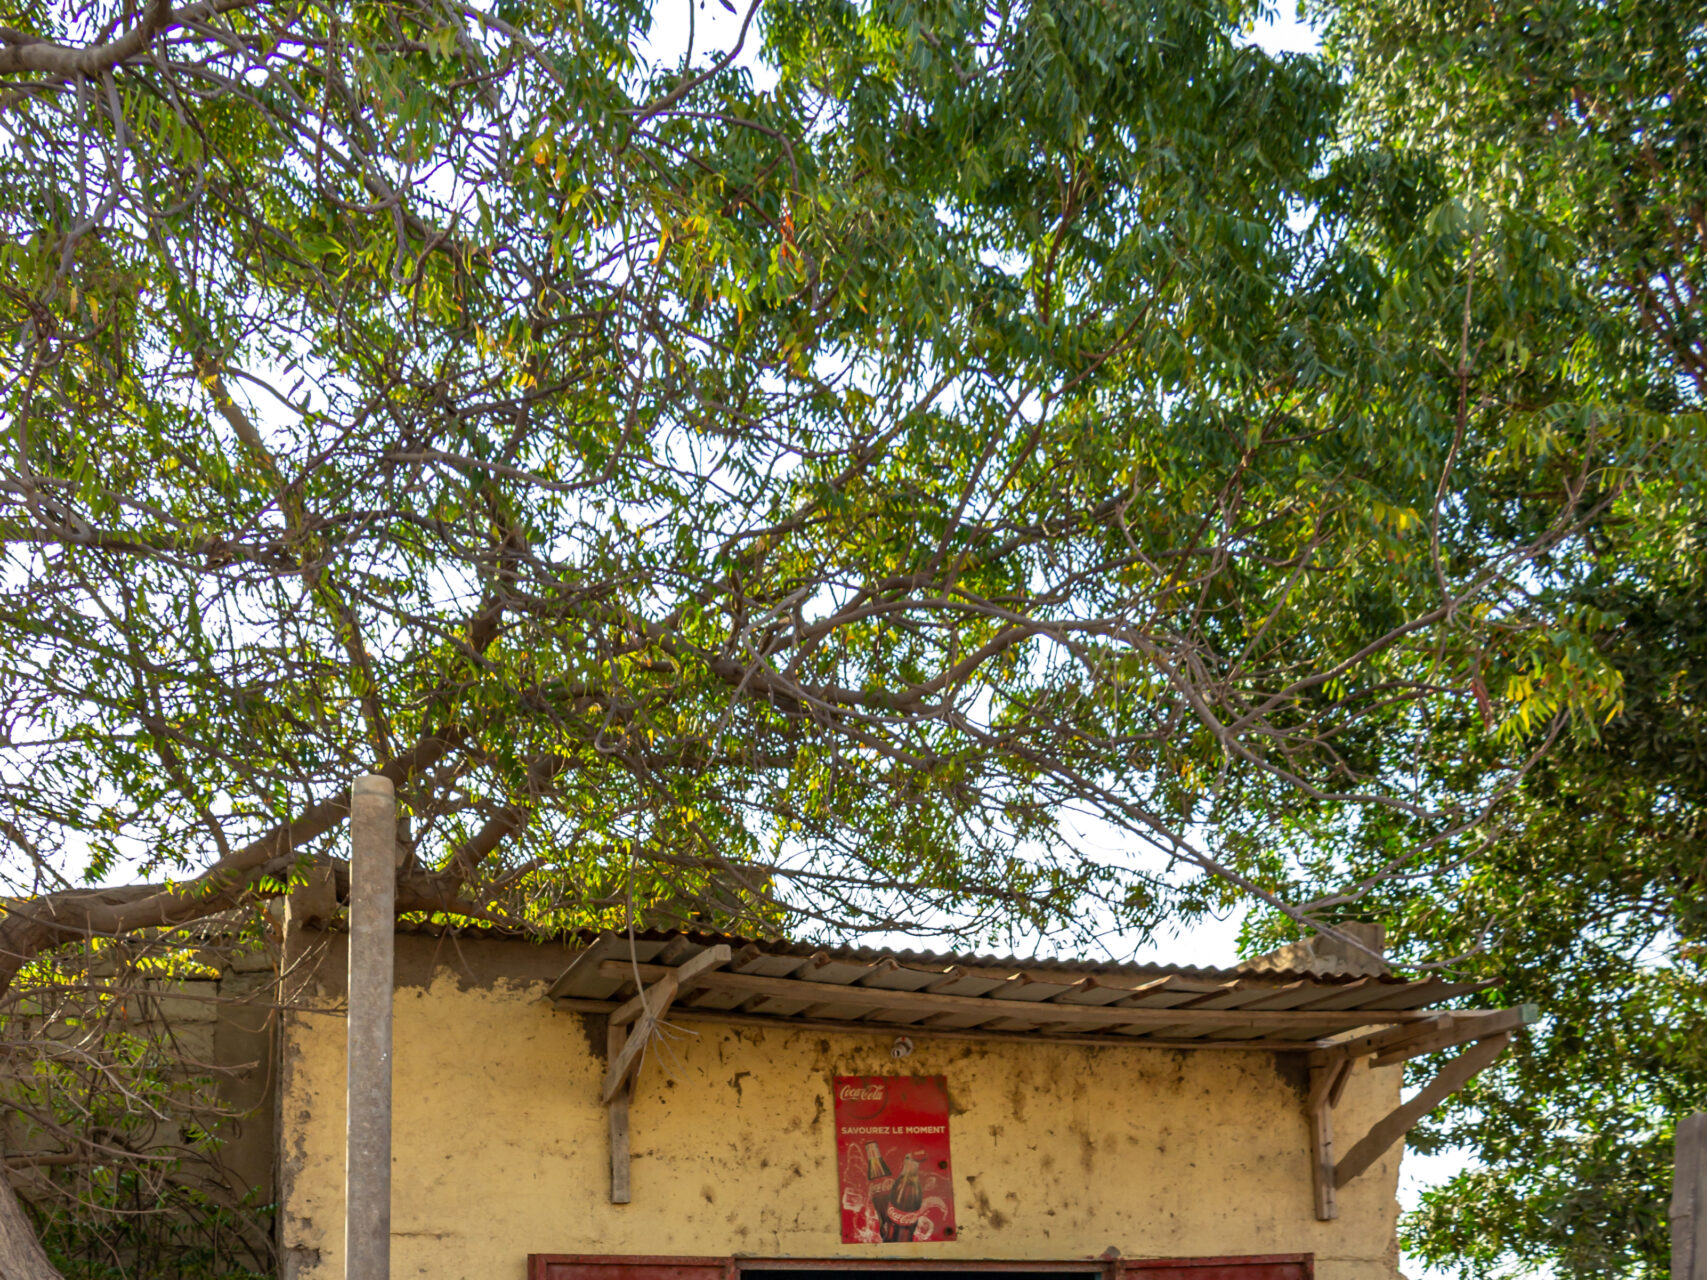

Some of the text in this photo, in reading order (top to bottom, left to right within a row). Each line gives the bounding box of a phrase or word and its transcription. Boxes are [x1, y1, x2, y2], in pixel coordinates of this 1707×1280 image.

[840, 1085, 884, 1100] Coca-Cola
[841, 1125, 945, 1134] SAVOUREZ LE MOMENT
